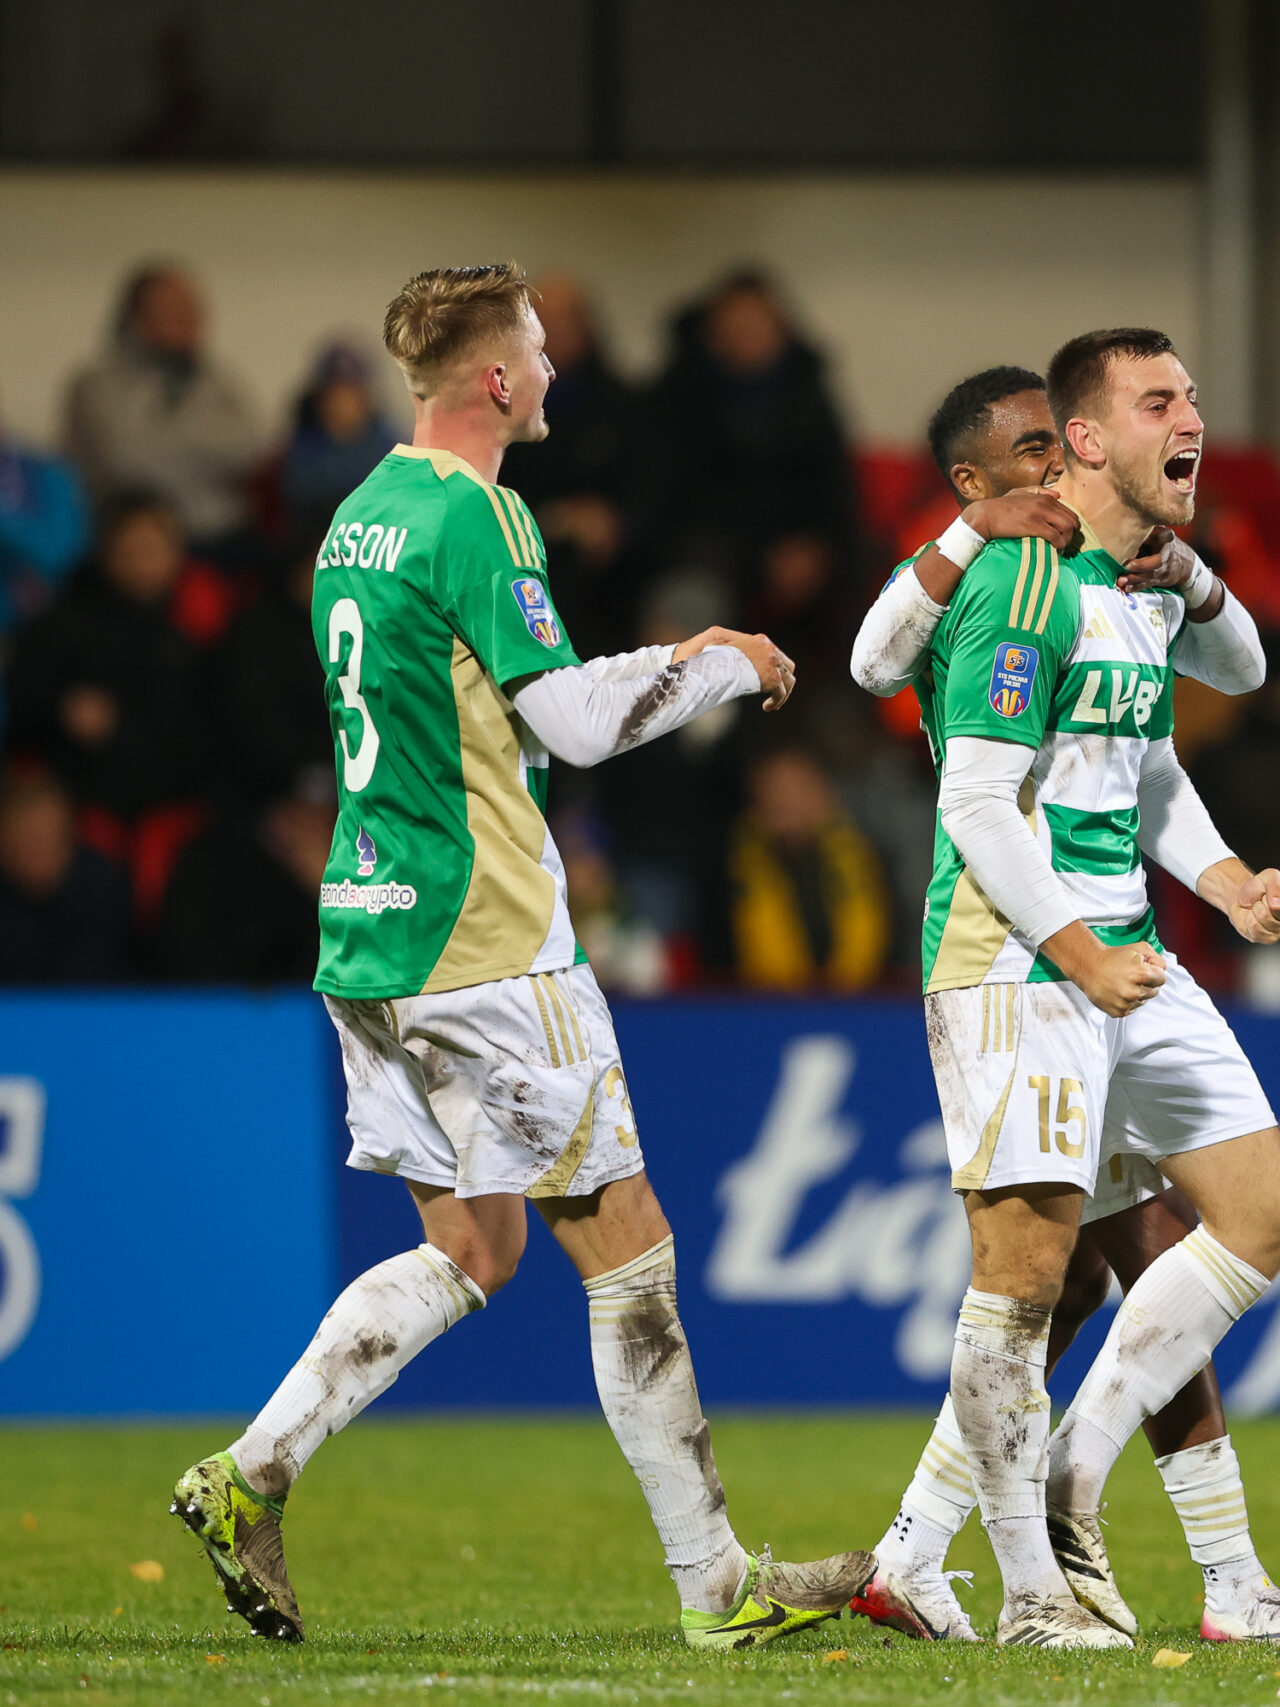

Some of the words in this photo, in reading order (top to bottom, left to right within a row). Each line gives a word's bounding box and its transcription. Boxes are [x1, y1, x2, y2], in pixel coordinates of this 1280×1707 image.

[317, 521, 408, 573] LSSON
[328, 597, 380, 792] 3
[1009, 655, 1025, 666] STS
[604, 1066, 638, 1149] 3
[1028, 1075, 1087, 1160] 15
